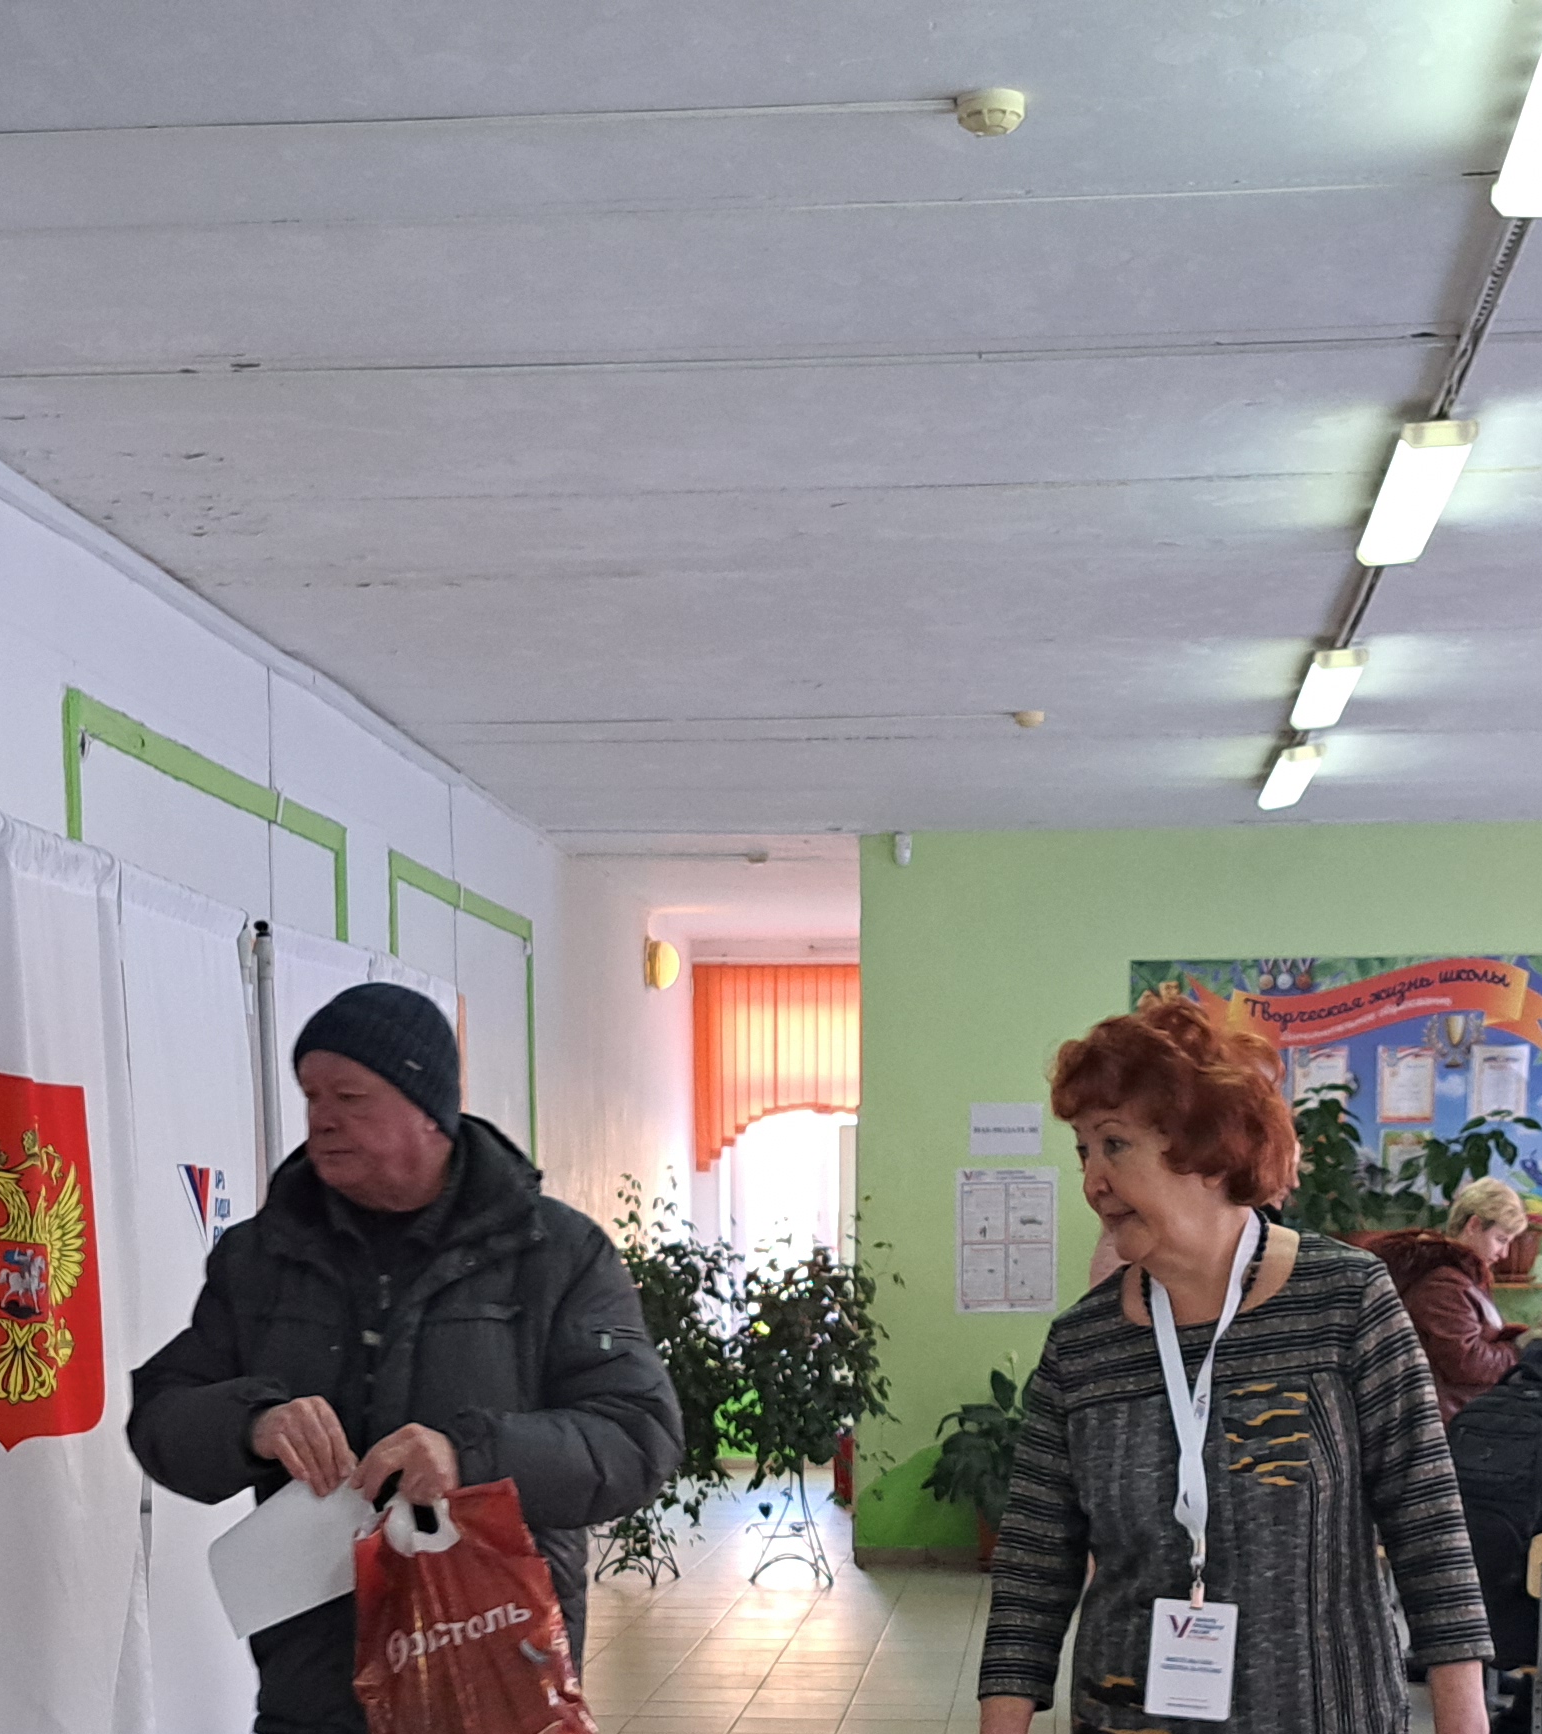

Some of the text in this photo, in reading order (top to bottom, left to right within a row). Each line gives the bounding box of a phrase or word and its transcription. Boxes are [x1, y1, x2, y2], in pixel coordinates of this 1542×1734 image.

[1245, 997, 1364, 1033] Творческая
[1368, 975, 1434, 1007] жизнь
[1438, 968, 1510, 988] школы
